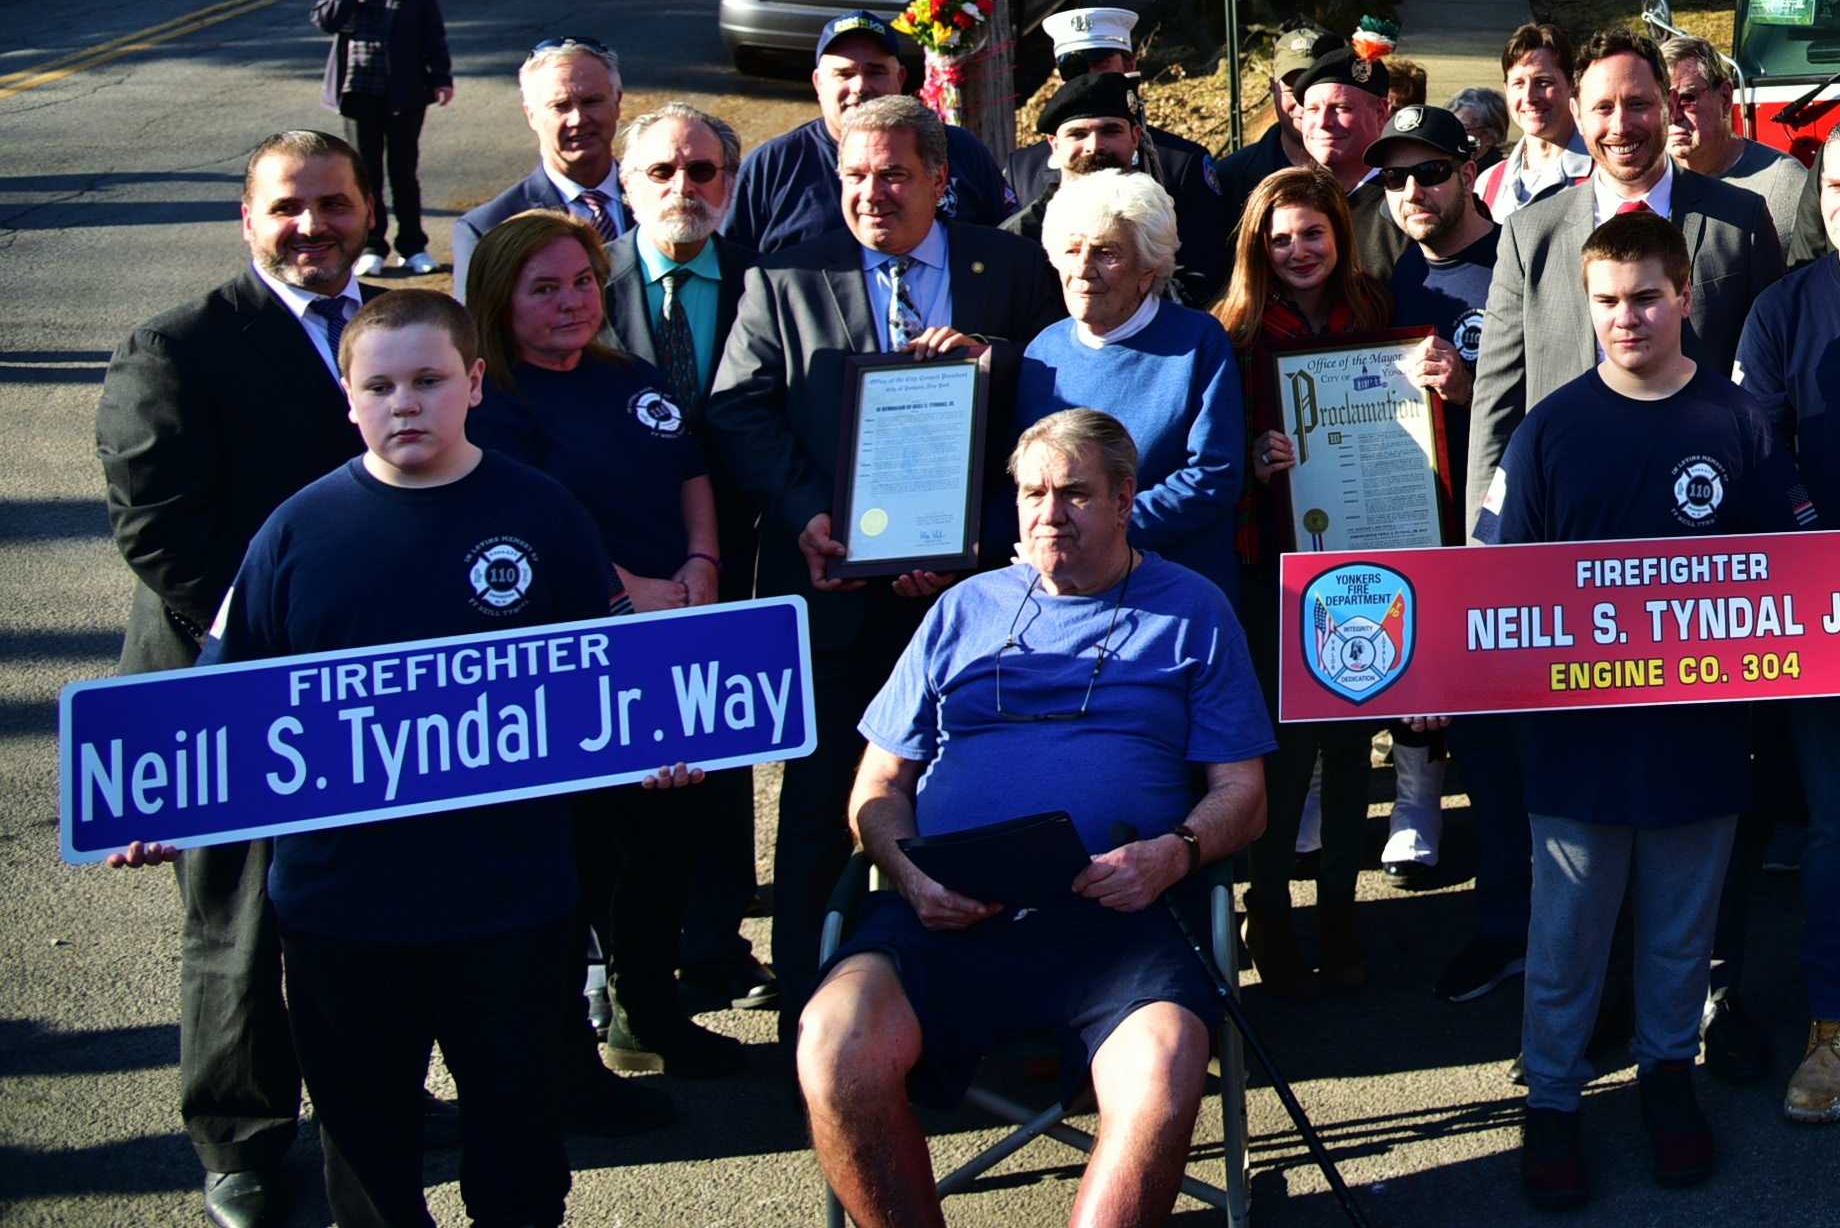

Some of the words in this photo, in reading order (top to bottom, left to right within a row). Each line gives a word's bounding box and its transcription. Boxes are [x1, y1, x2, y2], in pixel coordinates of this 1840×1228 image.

[1307, 358, 1337, 373] Office
[1338, 357, 1349, 370] of
[1352, 355, 1366, 366] the
[1368, 352, 1402, 367] Mayor
[1285, 368, 1421, 465] Proclamation
[1689, 484, 1711, 499] 110
[490, 567, 516, 583] 110
[1335, 573, 1382, 585] YONKERS
[1576, 552, 1770, 589] FIREFIGHTER
[1347, 584, 1370, 595] FIRE
[1325, 593, 1393, 606] DEPARTMENT
[1343, 625, 1374, 633] INTEGRITY
[1466, 604, 1576, 651] NEILL
[1593, 600, 1629, 646] S.
[1645, 594, 1804, 642] TYNDAL
[289, 633, 611, 707] FIREFIGHTER
[1341, 674, 1376, 683] DEDICATION
[1550, 658, 1665, 691] ENGINE
[1678, 656, 1730, 686] CO.
[1742, 652, 1801, 681] 304
[80, 725, 229, 822] Neill
[265, 715, 328, 796] S.
[338, 683, 549, 802] Tyndal
[578, 675, 664, 753] Jr.
[671, 660, 793, 745] Way
